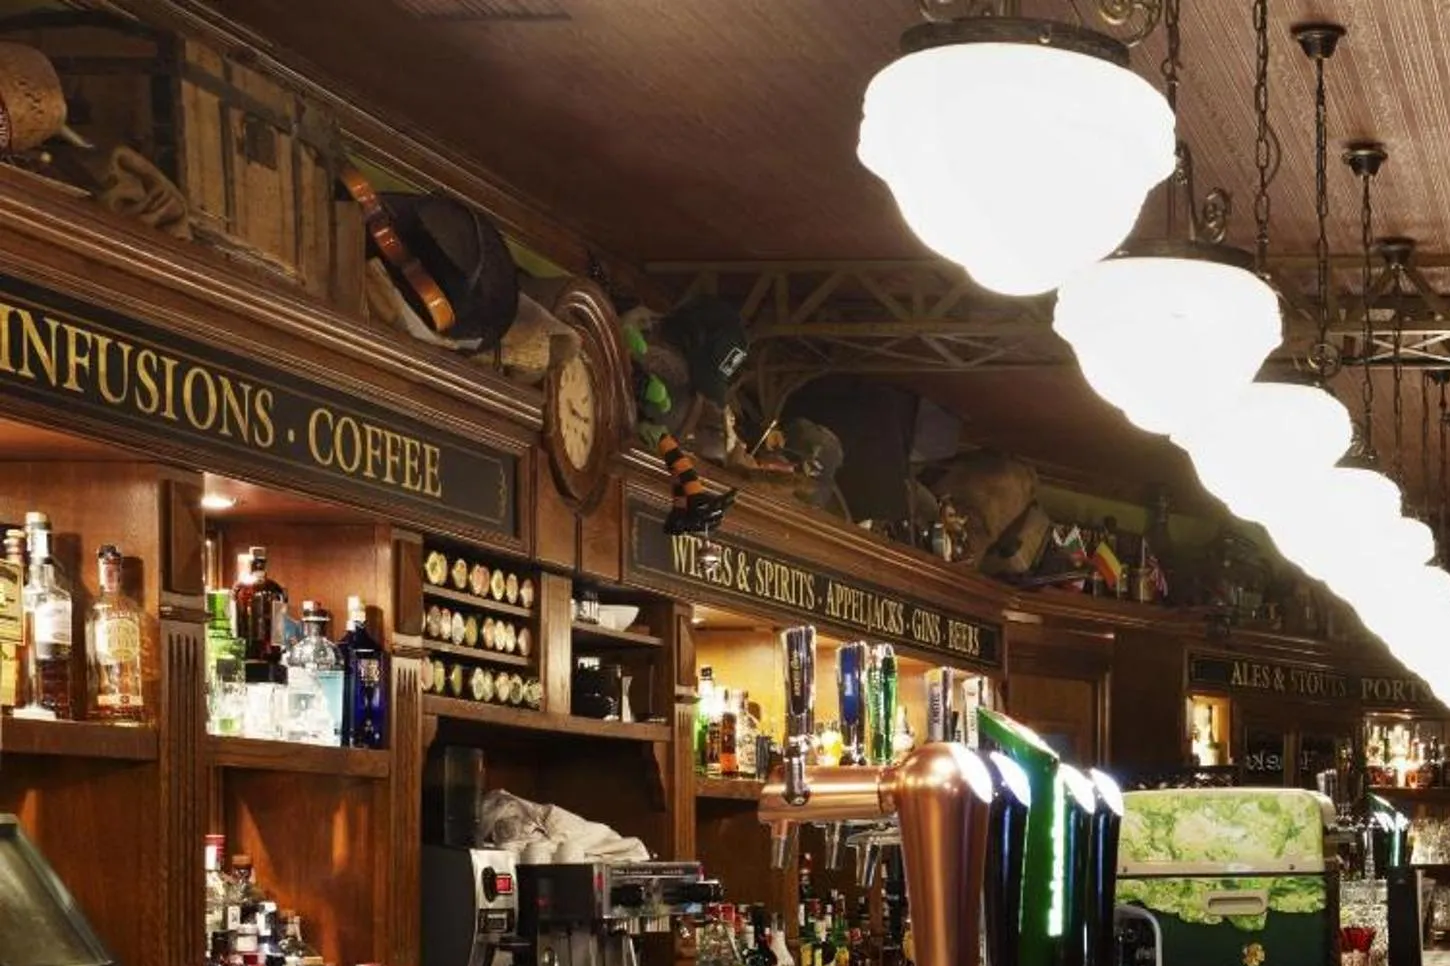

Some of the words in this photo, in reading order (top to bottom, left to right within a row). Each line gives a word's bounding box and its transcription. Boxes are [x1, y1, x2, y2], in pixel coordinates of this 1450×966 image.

[0, 305, 274, 447] INFUSIONS
[308, 407, 443, 498] COFFEE
[736, 551, 750, 592] &
[755, 557, 815, 610] SPIRITS
[912, 608, 941, 645] GINS
[1231, 661, 1270, 689] ALES
[1270, 667, 1285, 691] &
[1290, 669, 1347, 697] STOUTS
